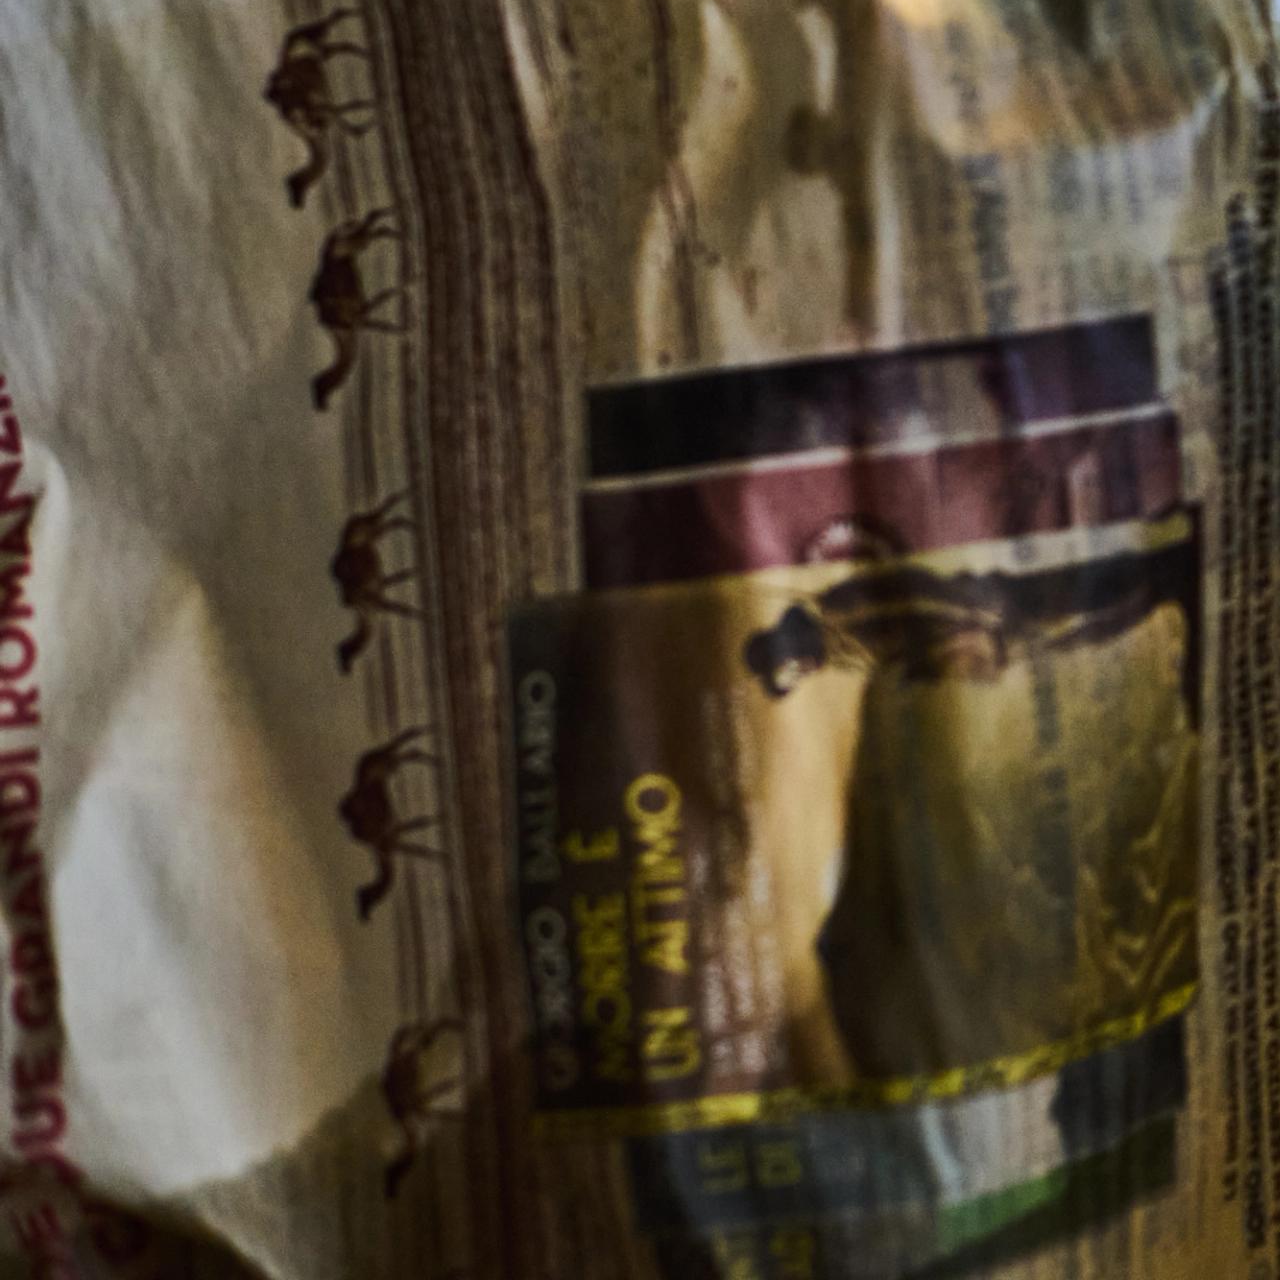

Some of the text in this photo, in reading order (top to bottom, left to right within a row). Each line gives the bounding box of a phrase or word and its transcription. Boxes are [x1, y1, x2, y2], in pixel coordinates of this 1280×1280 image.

[0, 392, 39, 728] ROMANZ
[0, 748, 58, 1032] GRANDI
[622, 772, 701, 1082] UN ATTIMO
